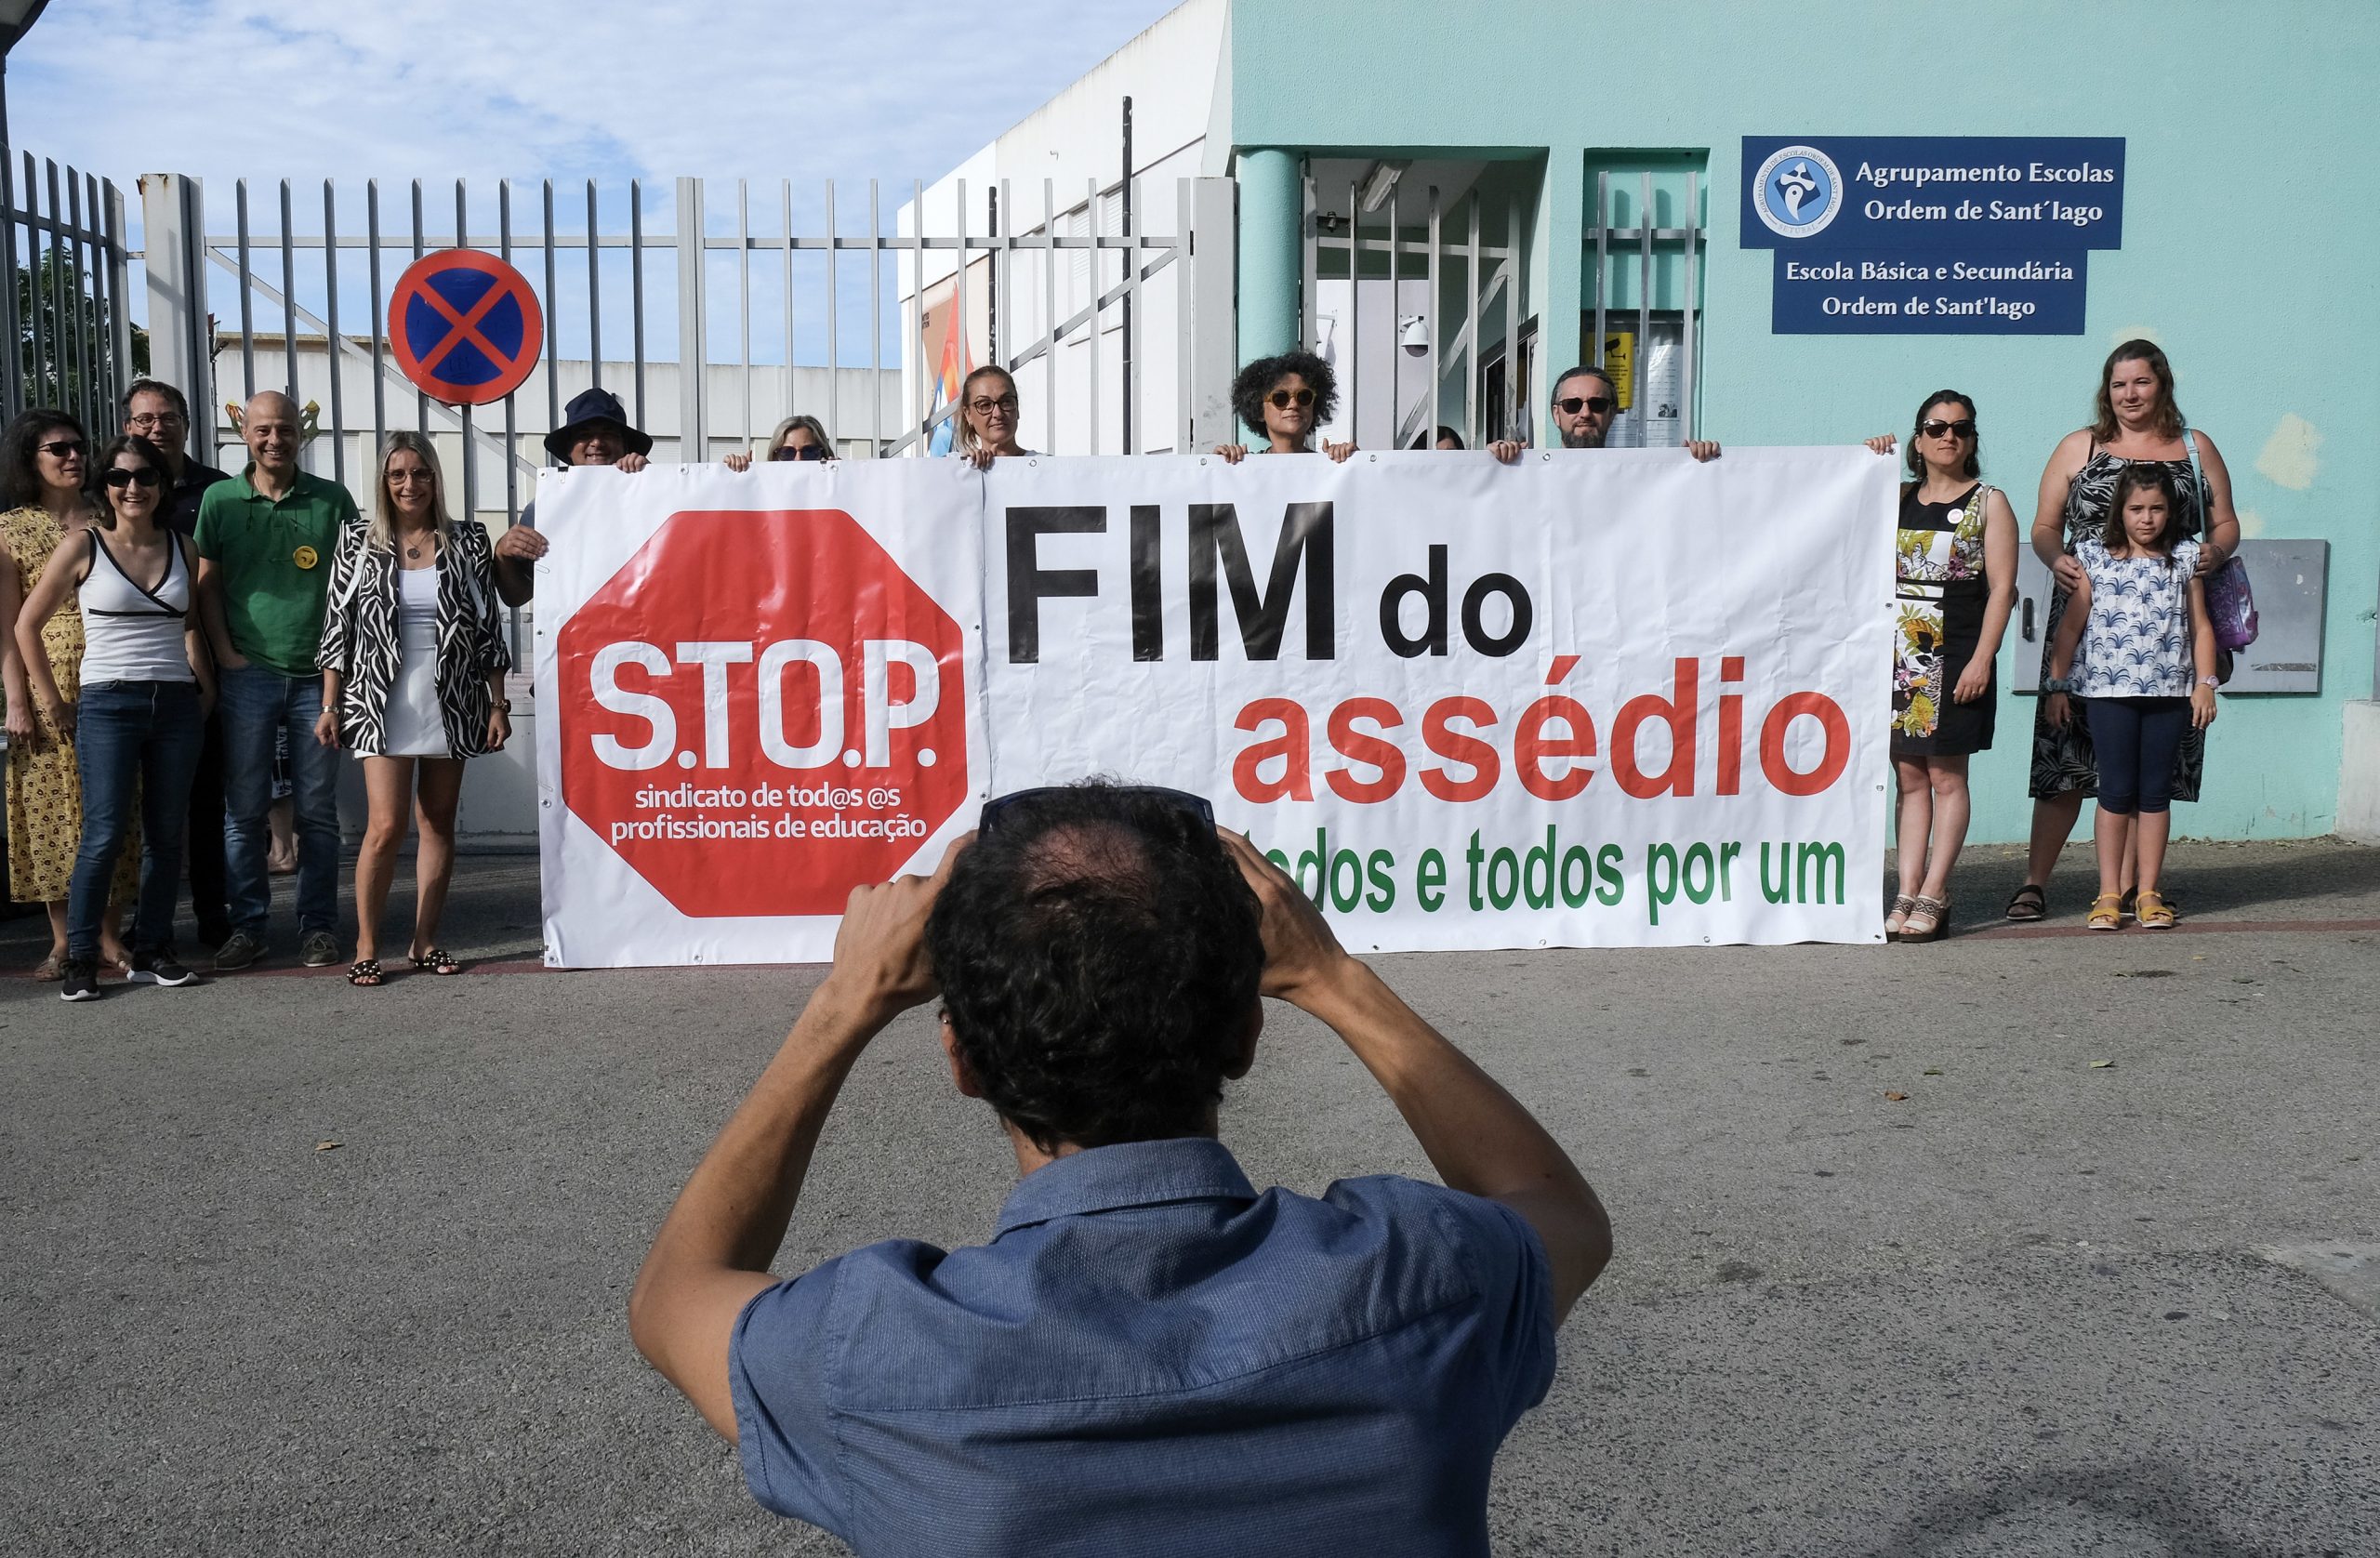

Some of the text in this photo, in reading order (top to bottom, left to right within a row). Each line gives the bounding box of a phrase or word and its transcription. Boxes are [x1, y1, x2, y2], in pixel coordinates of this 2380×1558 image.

[1855, 162, 2114, 188] Agrupamento Escolas
[1864, 199, 1947, 220] Ordem
[1954, 199, 1983, 220] de
[1787, 260, 2074, 281] Escola Básica e Secundária
[1822, 296, 2036, 321] Ordem de Sant'Iago
[1006, 502, 1533, 664] FIM do
[1233, 654, 1851, 804] assédio
[635, 782, 901, 810] sindicato de tod@s @s
[611, 812, 927, 846] profissionais de educação
[1416, 847, 1448, 912] e
[1466, 825, 1626, 911] todos
[1647, 840, 1741, 926] por
[1760, 840, 1846, 905] um
